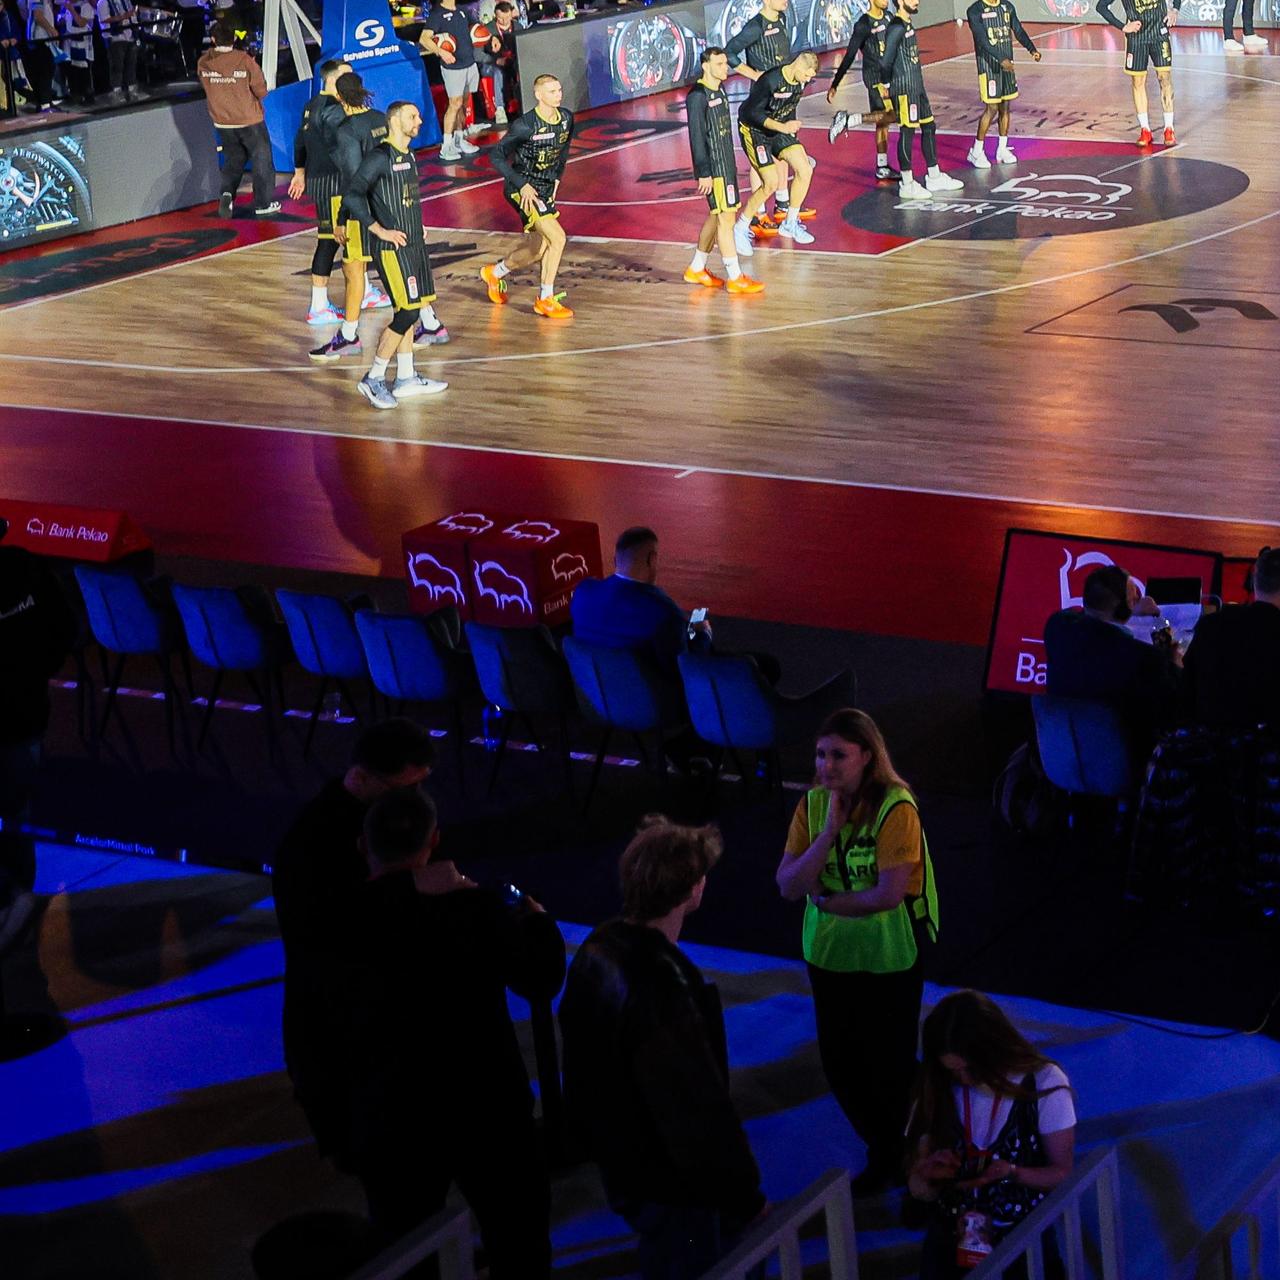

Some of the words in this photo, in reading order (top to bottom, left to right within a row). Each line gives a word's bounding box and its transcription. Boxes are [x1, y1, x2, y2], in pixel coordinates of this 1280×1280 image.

[12, 147, 66, 182] AEROWATCH
[996, 204, 1118, 221] Pekao
[49, 523, 75, 539] Bank
[76, 526, 109, 542] Pekao
